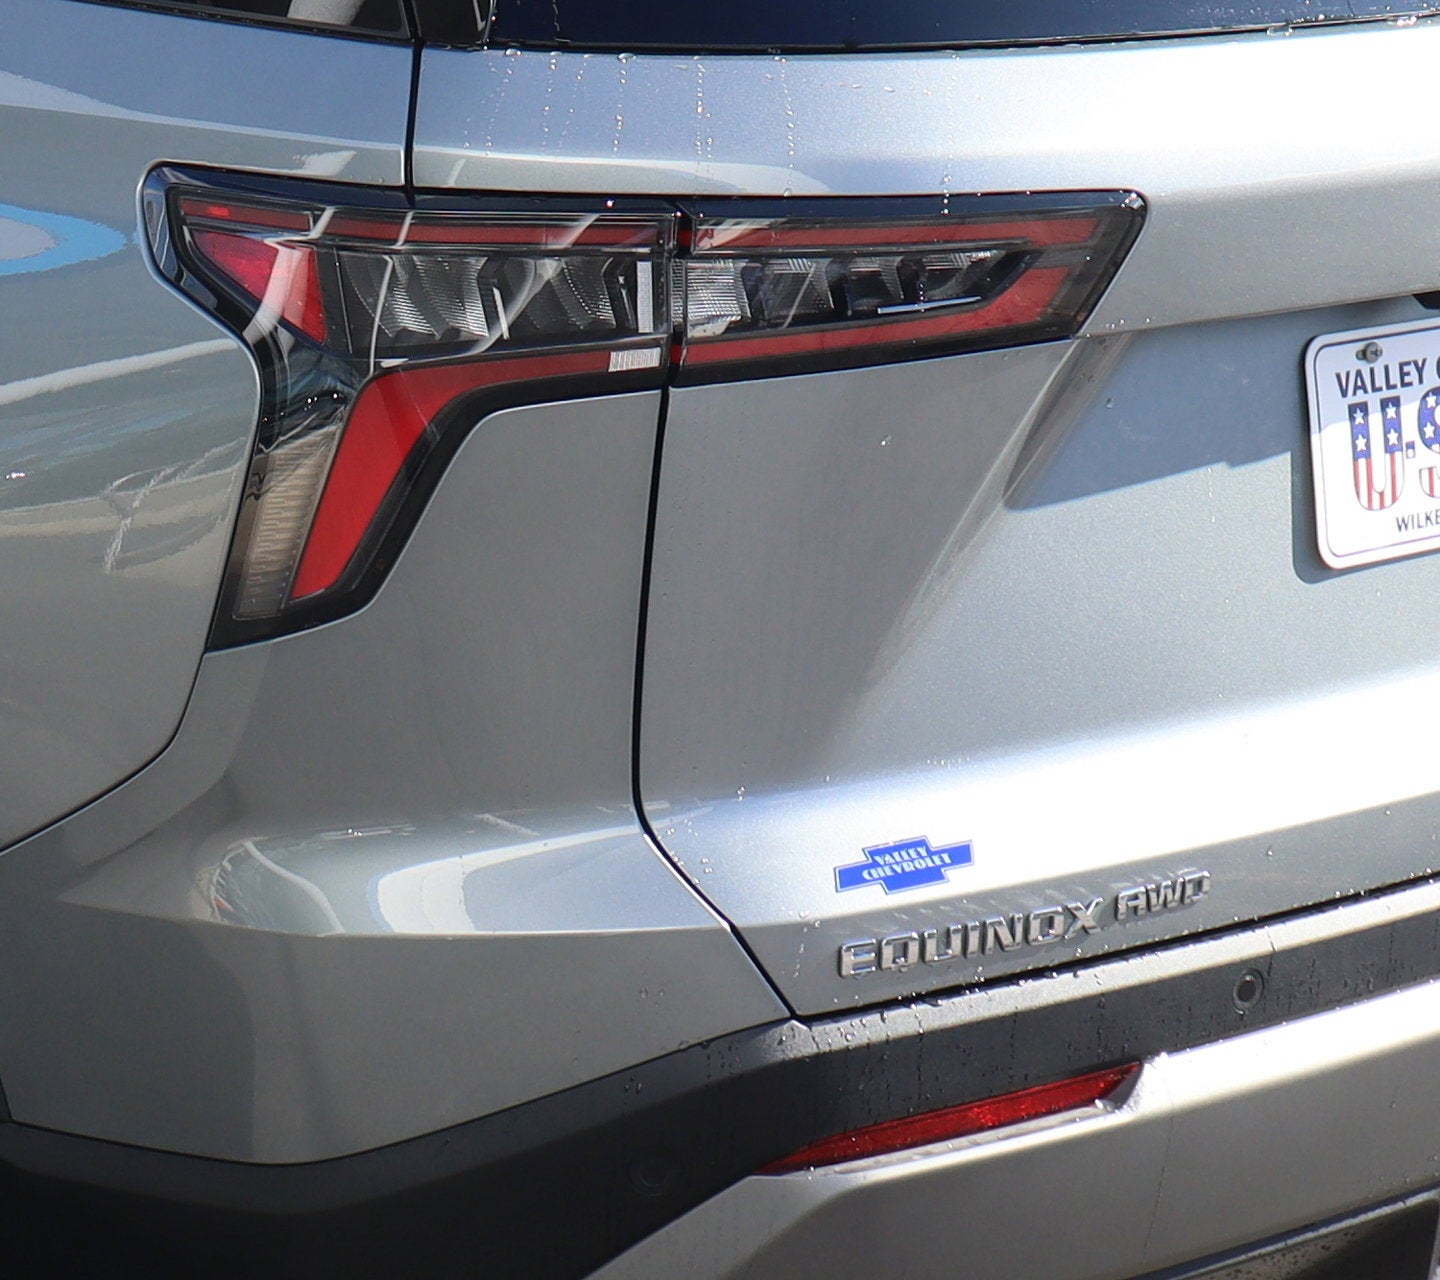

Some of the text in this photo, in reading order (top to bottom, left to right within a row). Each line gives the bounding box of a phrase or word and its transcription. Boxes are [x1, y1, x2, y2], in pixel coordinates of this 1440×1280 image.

[1335, 357, 1428, 399] VALLEY
[861, 852, 952, 881] CHEVROLET
[874, 846, 928, 866] VALLEY
[839, 868, 1211, 979] EQUINOX AWD
